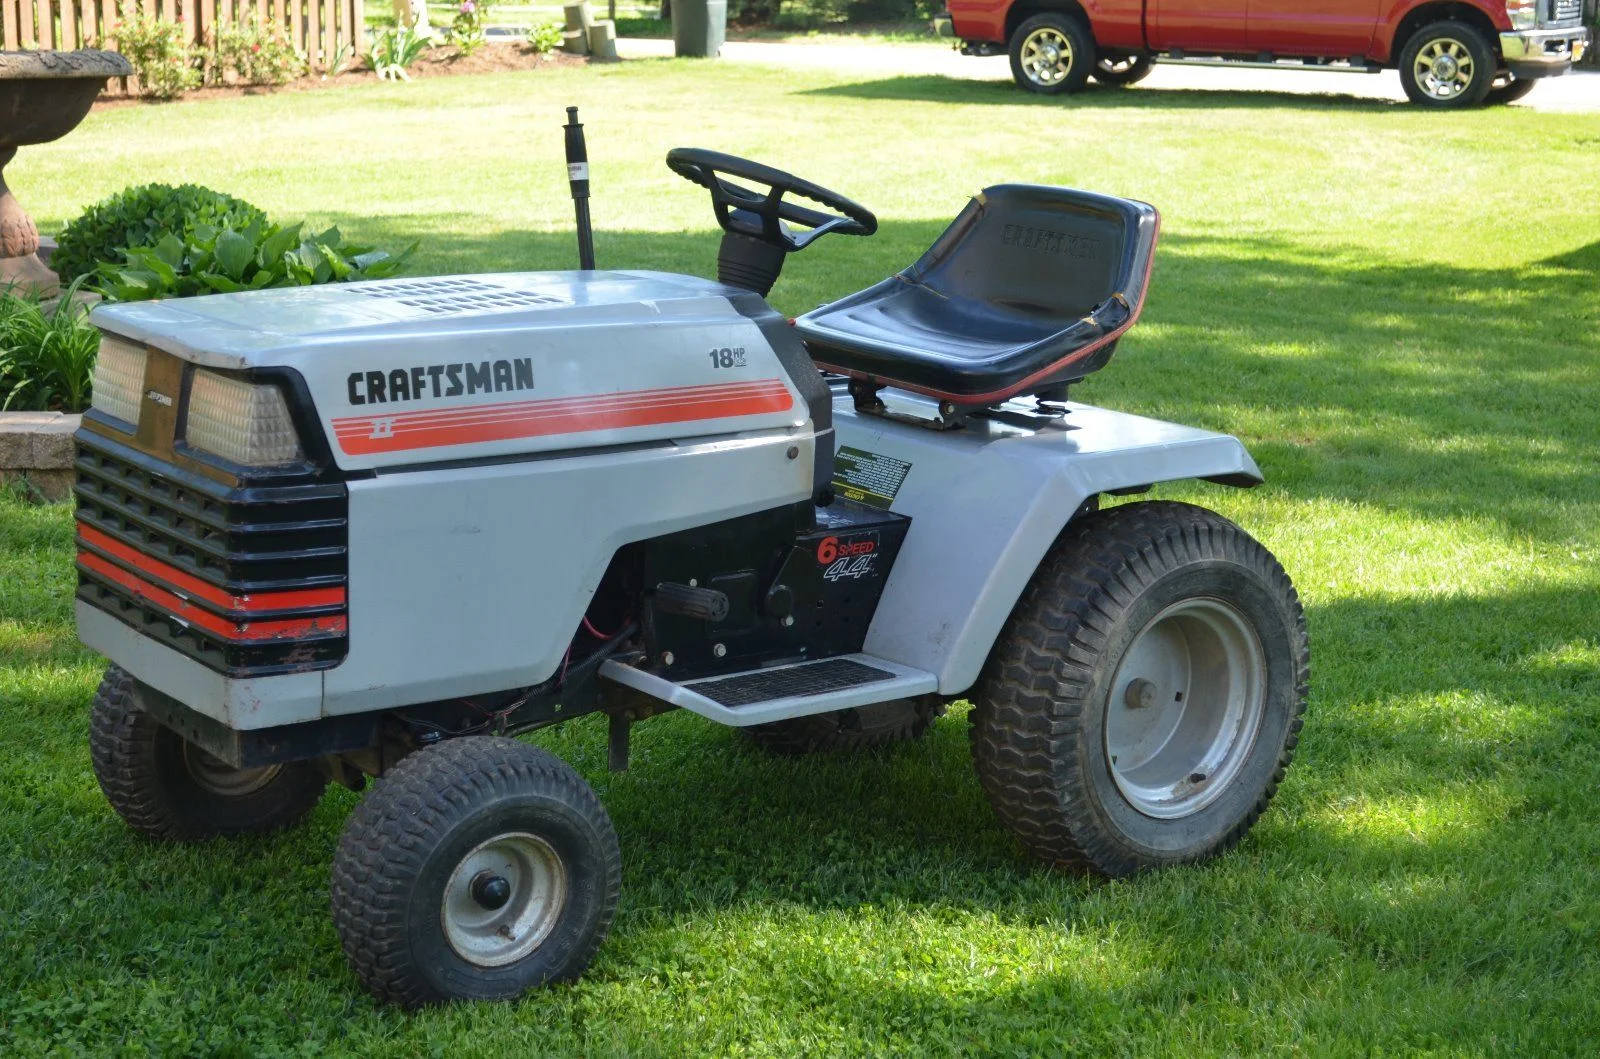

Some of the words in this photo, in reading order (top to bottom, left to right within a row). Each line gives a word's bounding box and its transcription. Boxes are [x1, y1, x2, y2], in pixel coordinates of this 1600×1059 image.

[709, 348, 734, 369] 18
[733, 347, 745, 358] HP
[347, 357, 535, 406] CRAFTSMAN
[818, 536, 839, 564] 6
